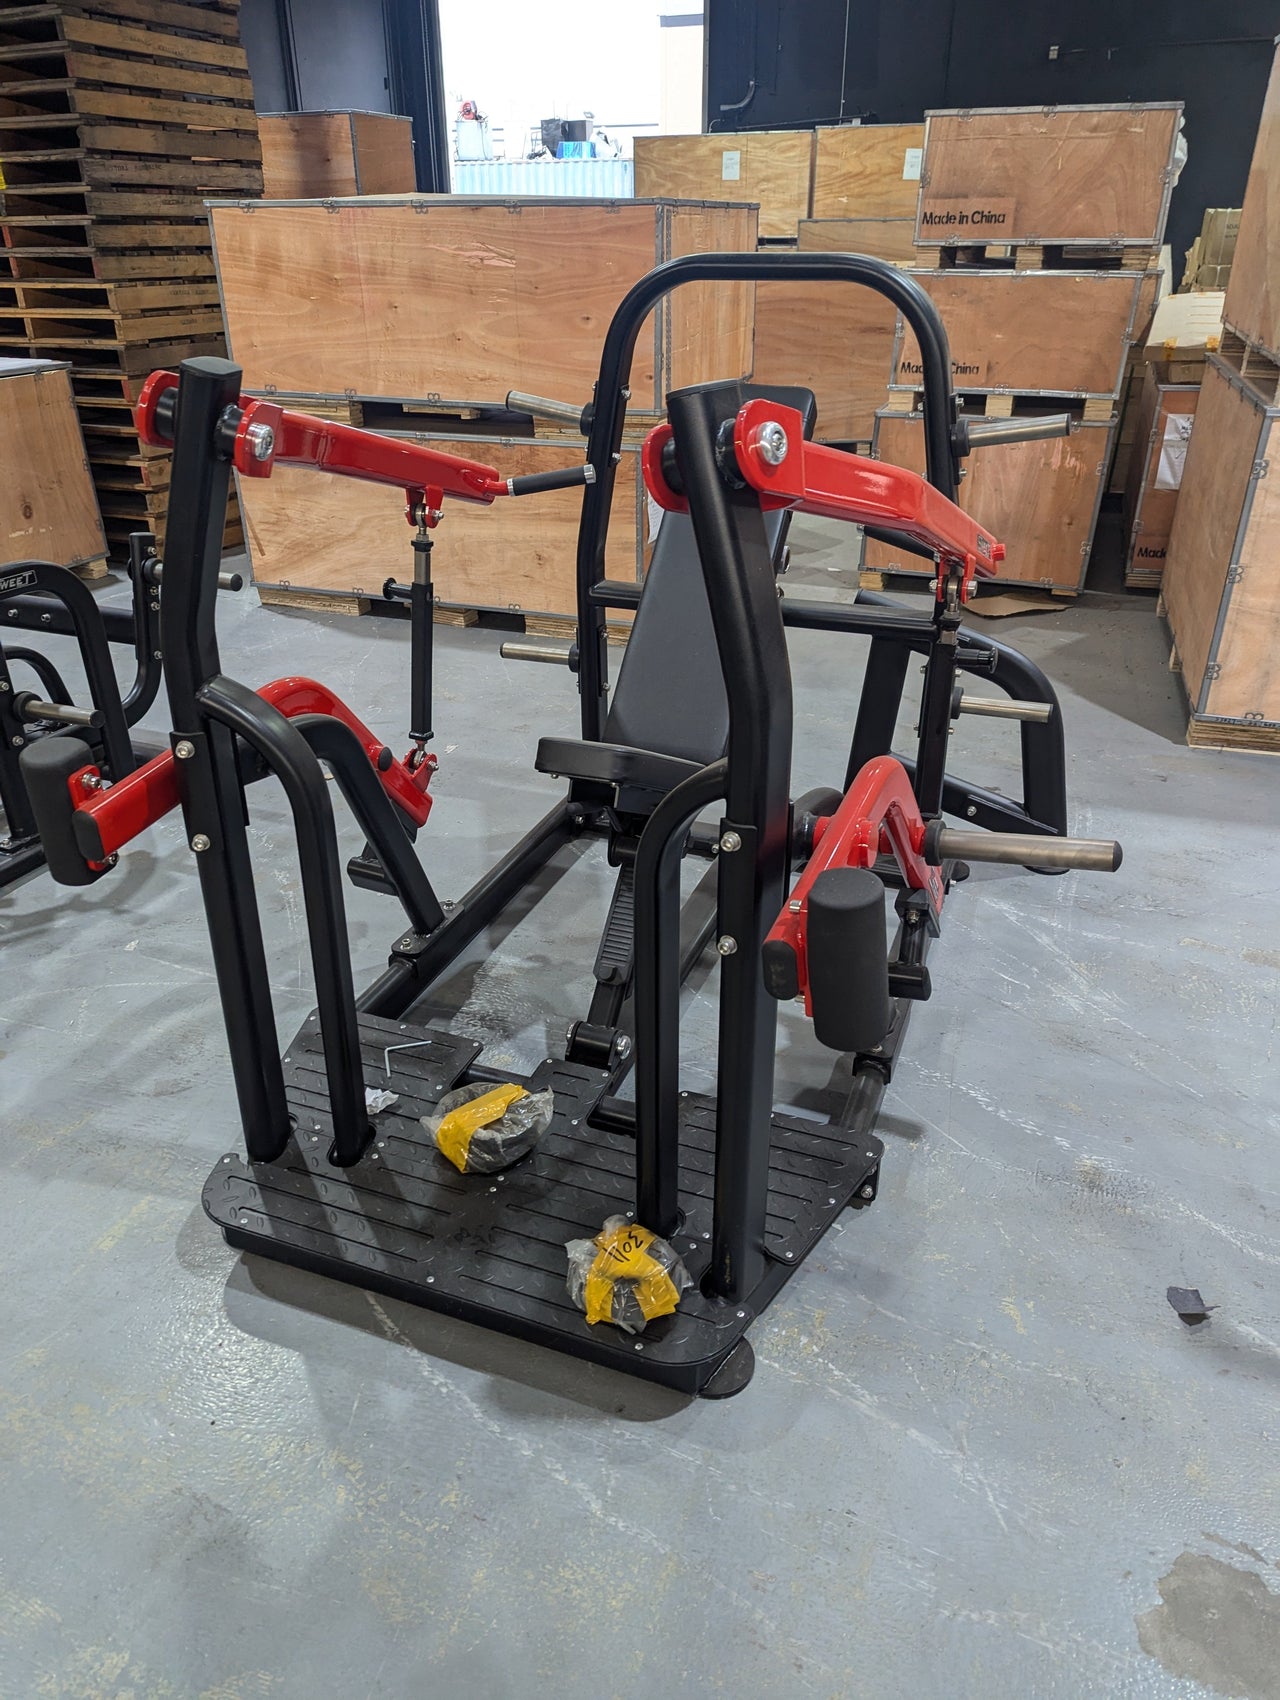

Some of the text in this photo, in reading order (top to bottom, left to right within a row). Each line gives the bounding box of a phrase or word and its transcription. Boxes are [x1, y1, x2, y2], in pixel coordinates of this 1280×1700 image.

[922, 210, 1006, 225] Made in China
[901, 361, 924, 374] Ma
